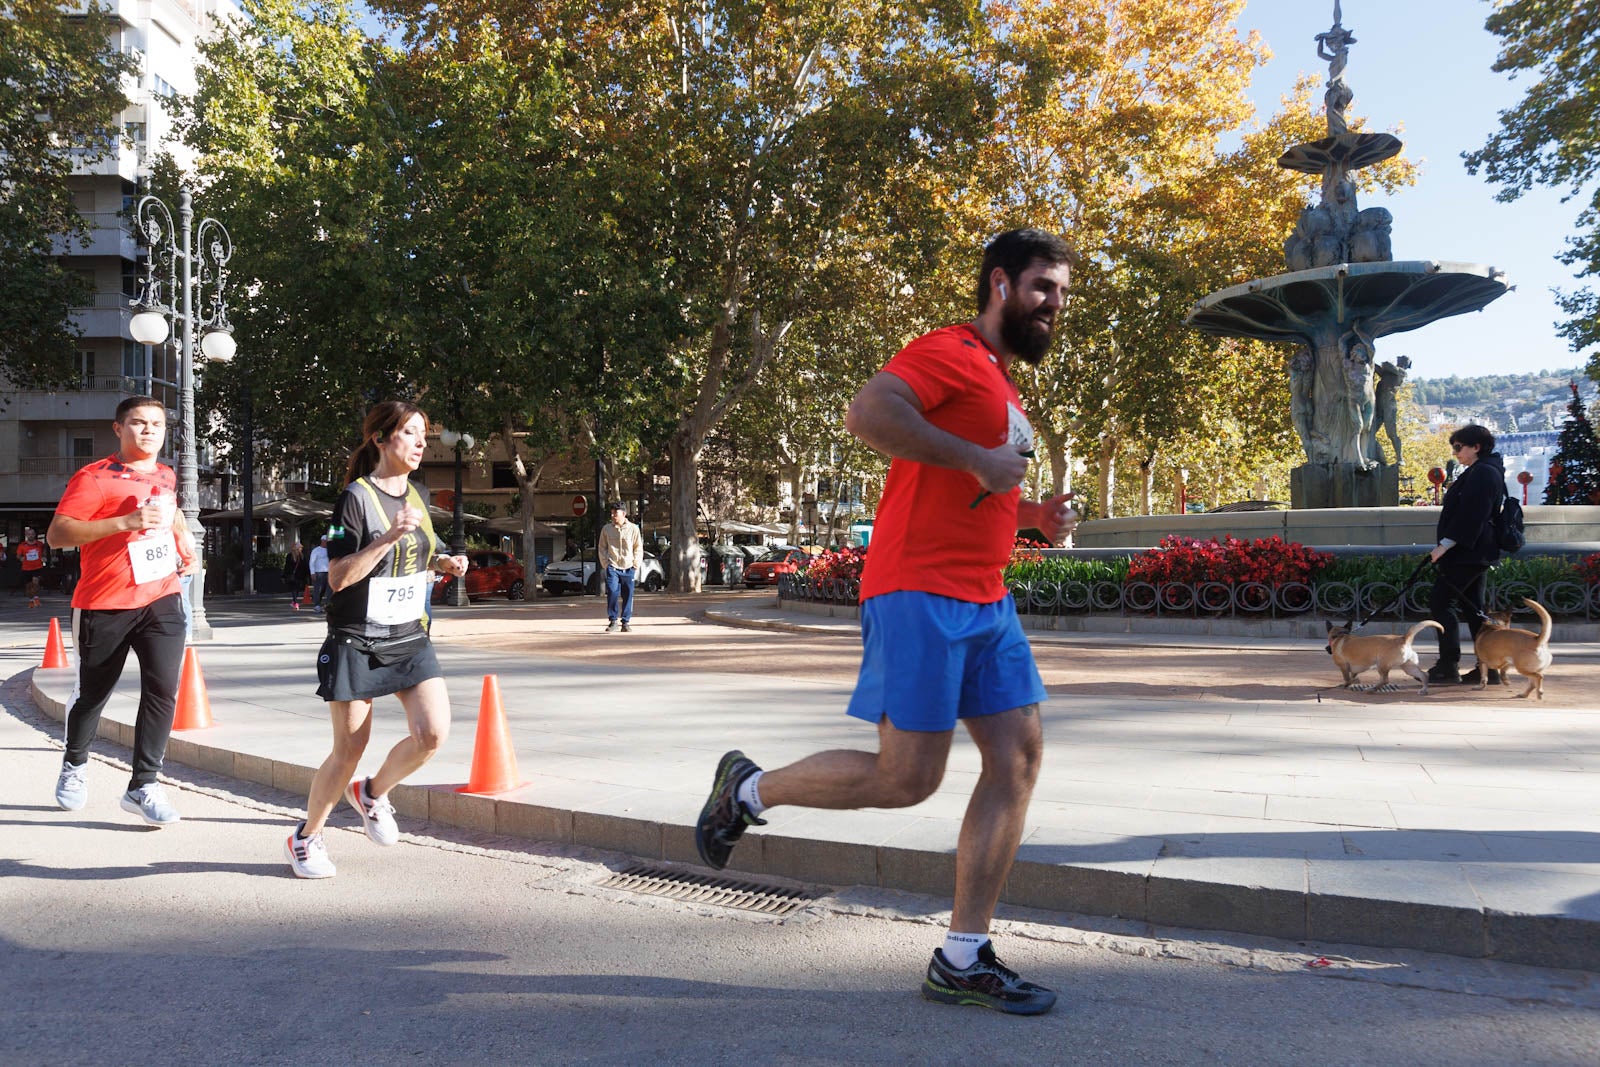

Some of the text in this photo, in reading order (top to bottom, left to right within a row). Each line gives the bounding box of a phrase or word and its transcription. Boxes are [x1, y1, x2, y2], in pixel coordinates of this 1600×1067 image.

[145, 544, 169, 561] 883
[387, 586, 414, 603] 795
[947, 935, 979, 943] adidas
